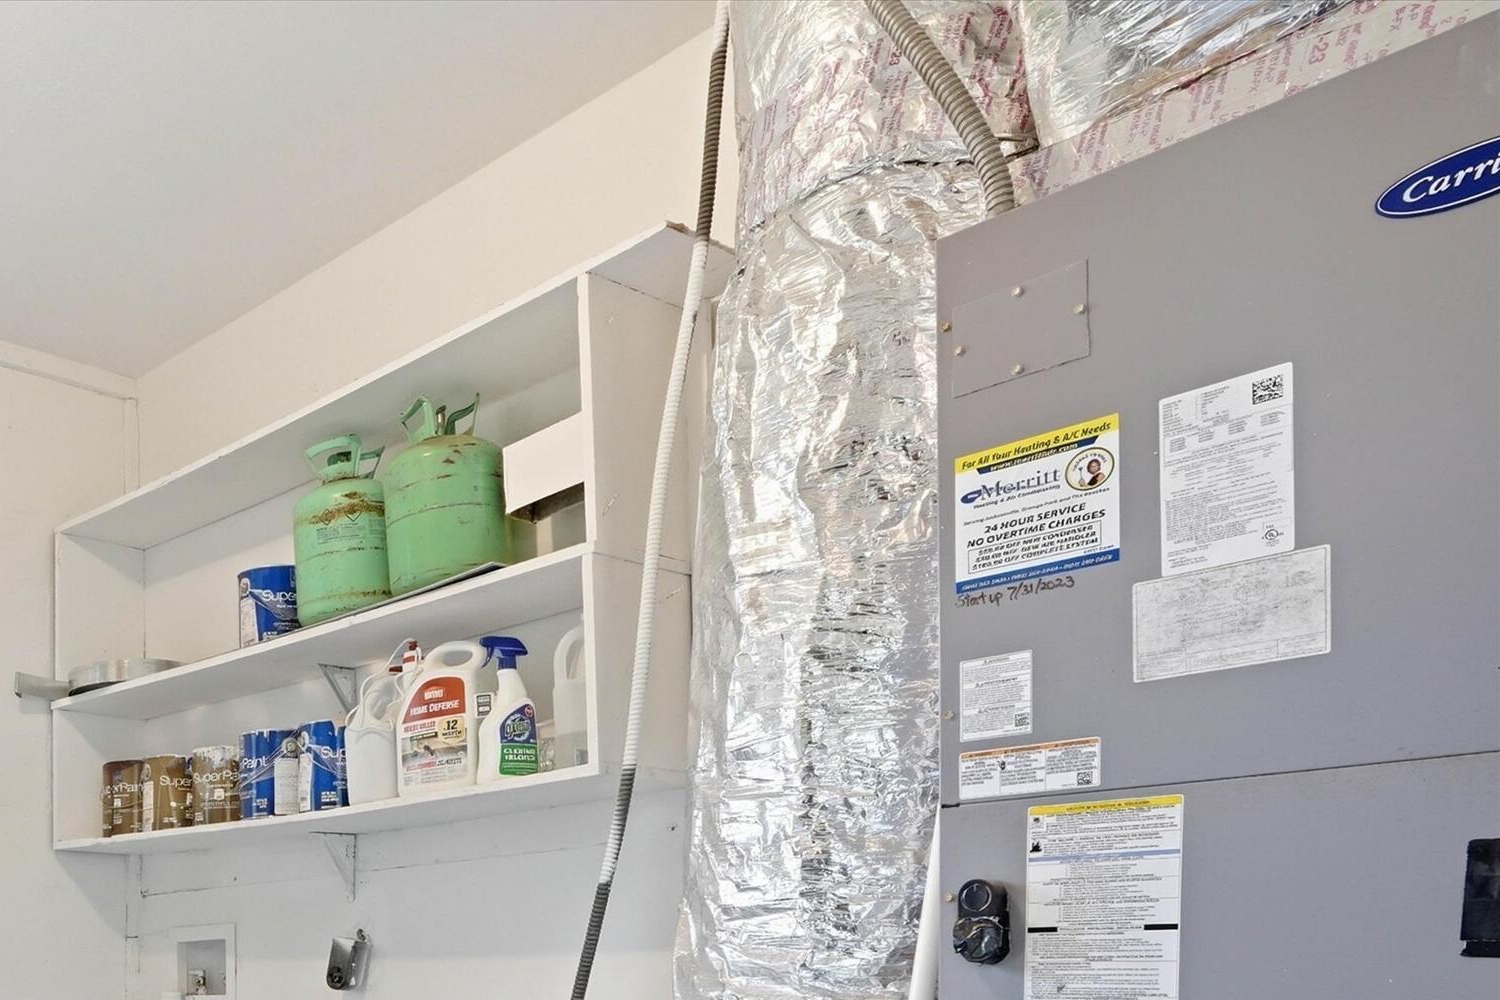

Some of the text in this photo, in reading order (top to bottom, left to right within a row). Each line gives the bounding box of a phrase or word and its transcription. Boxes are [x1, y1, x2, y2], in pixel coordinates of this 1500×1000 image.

[961, 422, 1111, 470] For All Your Heating & A/C Needs
[980, 469, 1061, 501] Merritt
[967, 508, 1106, 549] NO OVERTIME CHARGES
[984, 502, 1087, 534] 24 HOUR SERVICE
[1006, 575, 1076, 601] 7/31/2023
[410, 700, 460, 716] HOME DEFENSE
[242, 755, 268, 769] Paint
